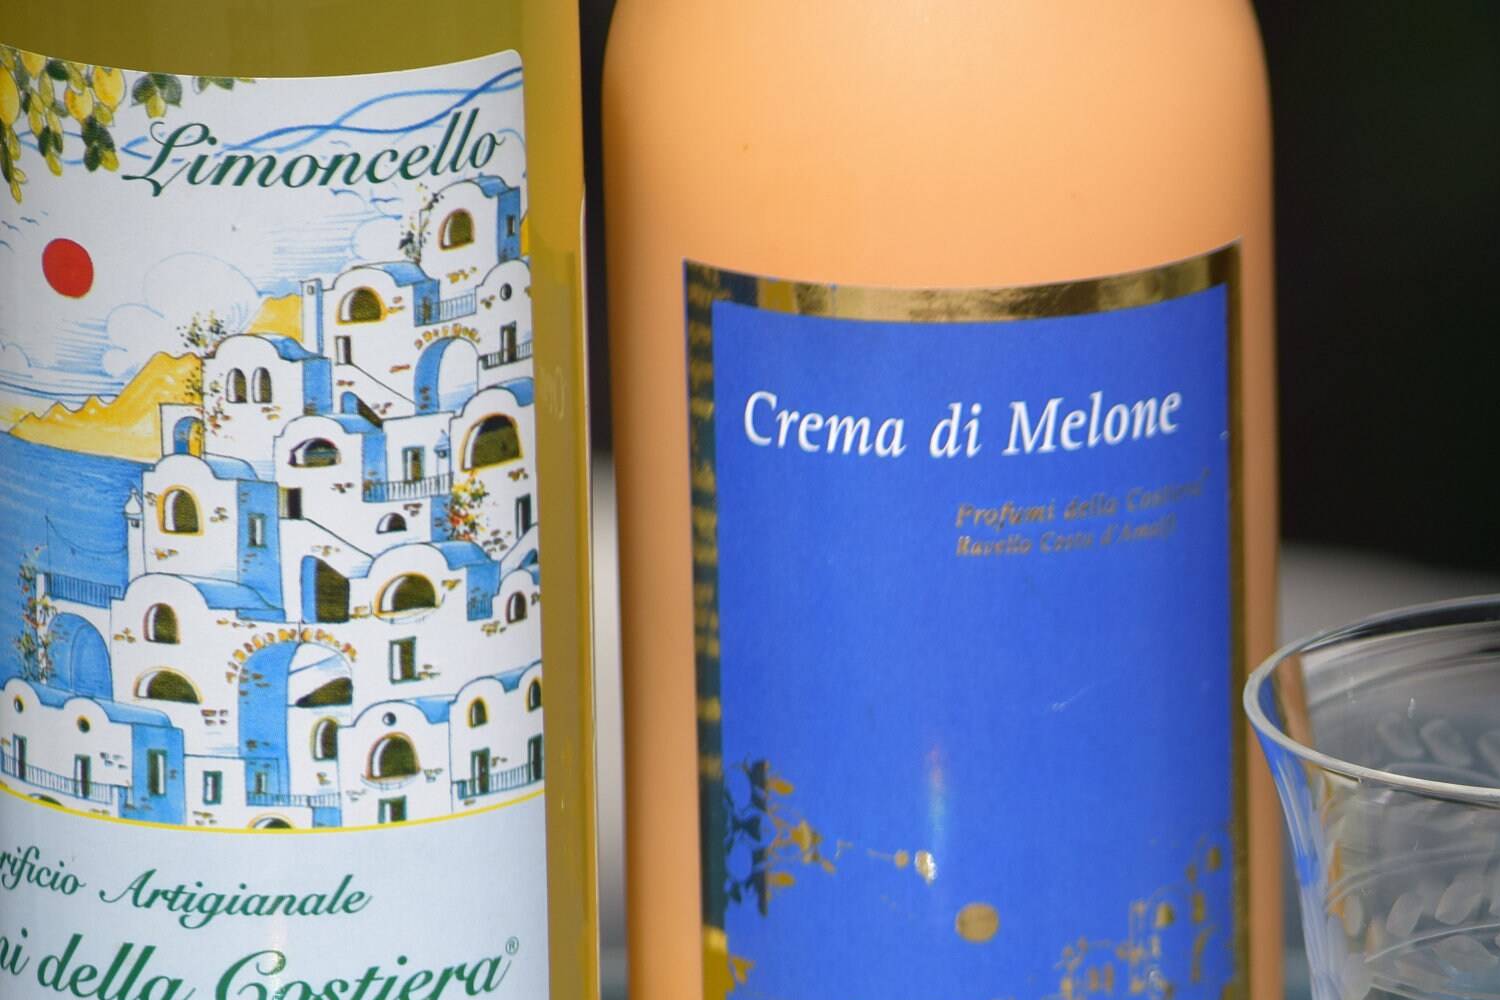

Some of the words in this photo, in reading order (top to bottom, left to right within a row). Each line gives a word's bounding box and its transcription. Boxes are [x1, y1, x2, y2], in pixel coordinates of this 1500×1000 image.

[121, 107, 506, 197] Limoncello
[743, 390, 907, 457] Crema
[928, 402, 983, 458] di
[1001, 390, 1183, 456] Melone
[955, 499, 1055, 531] Profumi
[98, 868, 373, 929] Artigianale
